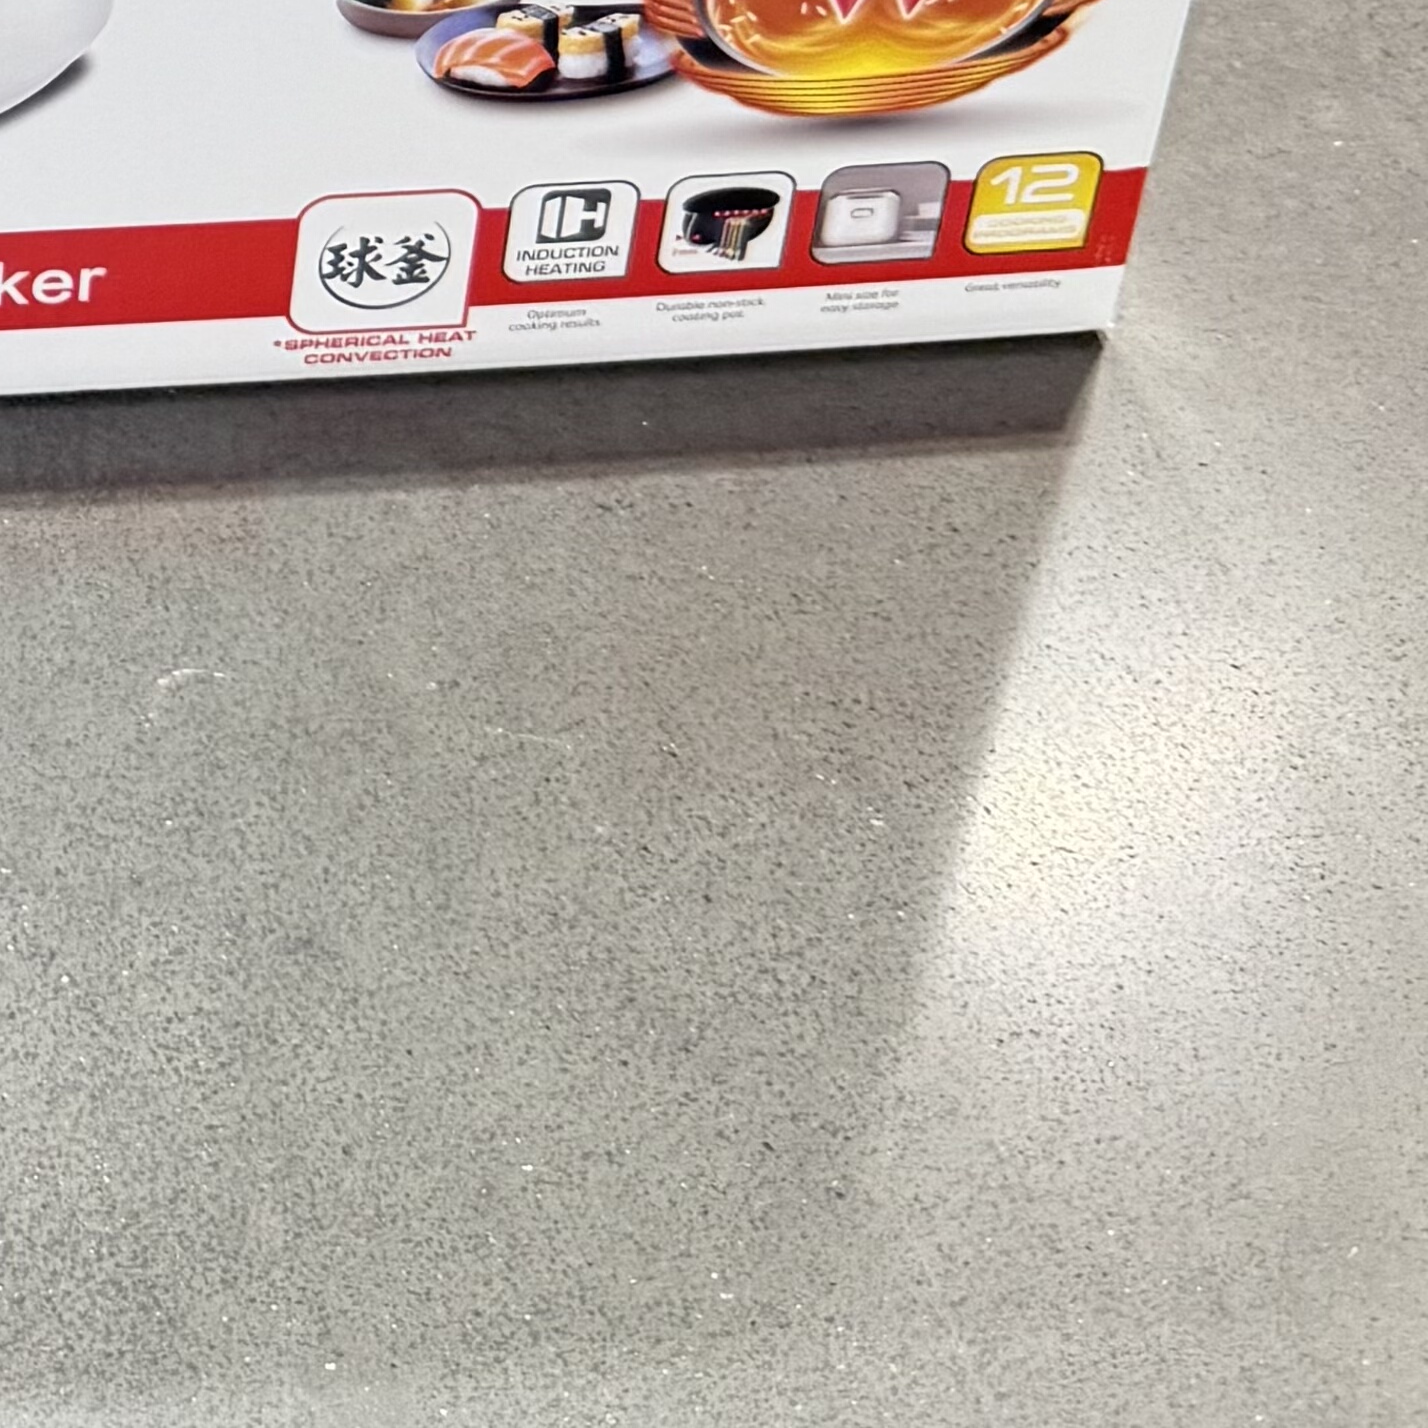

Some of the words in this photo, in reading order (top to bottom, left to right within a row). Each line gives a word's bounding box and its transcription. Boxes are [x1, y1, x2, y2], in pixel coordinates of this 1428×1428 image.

[990, 163, 1079, 205] 12
[321, 233, 450, 289] 球釜
[516, 245, 619, 262] INDUCTION
[525, 259, 606, 276] HEATING
[417, 330, 478, 345] HEAT
[303, 347, 453, 365] CONVECTION
